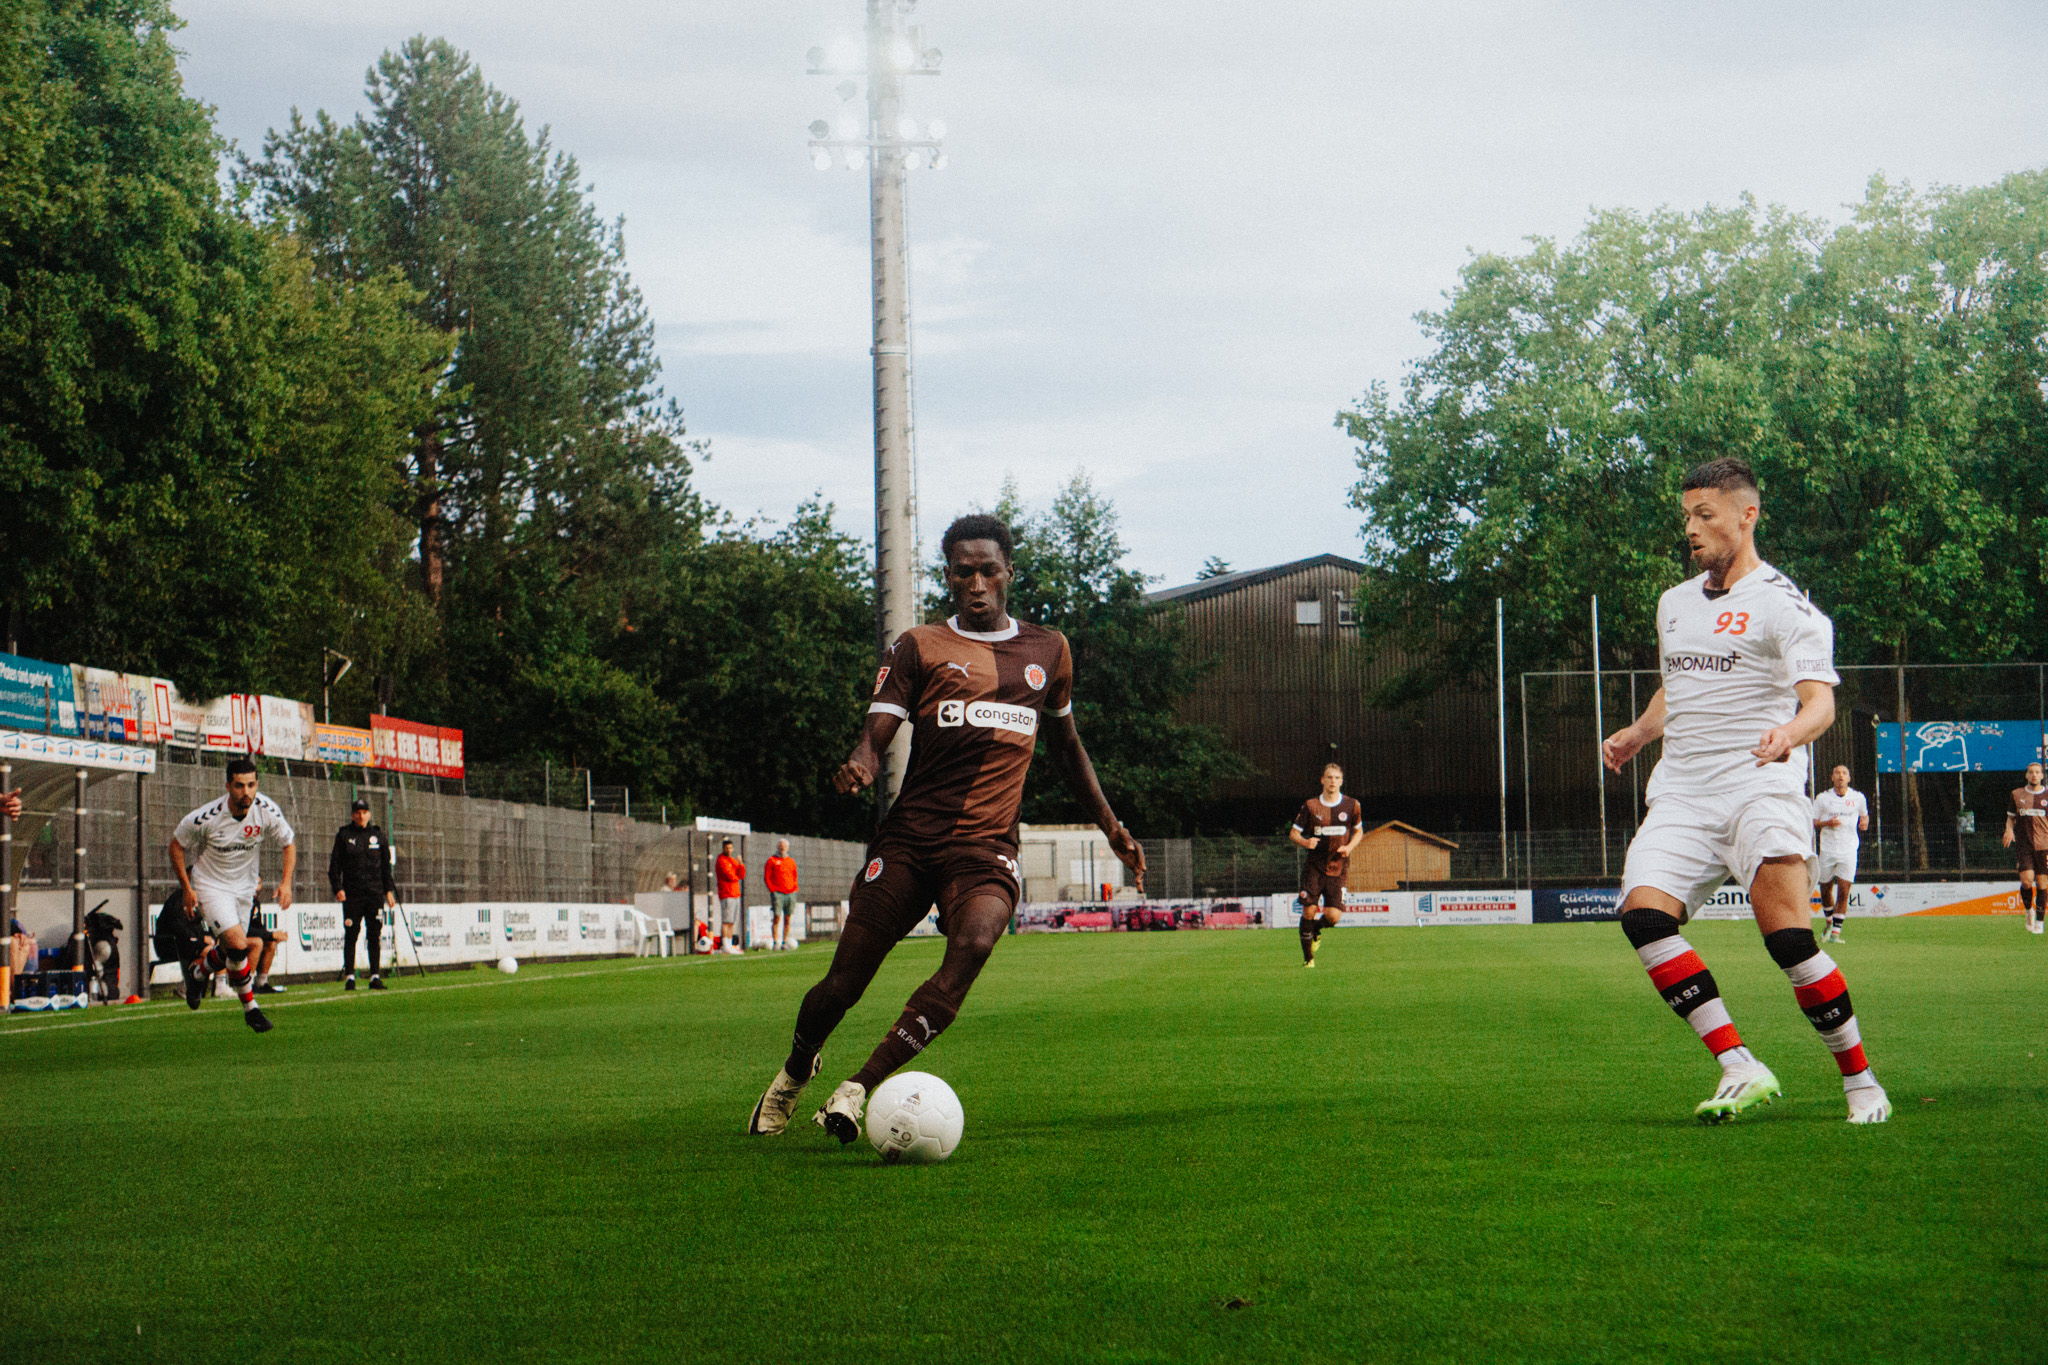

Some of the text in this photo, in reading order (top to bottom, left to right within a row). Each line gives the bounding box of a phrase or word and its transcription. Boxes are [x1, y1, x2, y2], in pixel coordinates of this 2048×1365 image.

[1713, 611, 1750, 635] 93
[975, 709, 1034, 726] congstar
[397, 731, 419, 761] REWE
[419, 735, 440, 765] REWE
[441, 739, 463, 768] REWE
[244, 824, 261, 838] 93
[303, 911, 335, 930] Stadtwerke
[415, 911, 442, 928] Stadtwerke
[423, 931, 451, 947] Norderstedt
[1682, 984, 1700, 999] 93
[1824, 1007, 1841, 1021] 93
